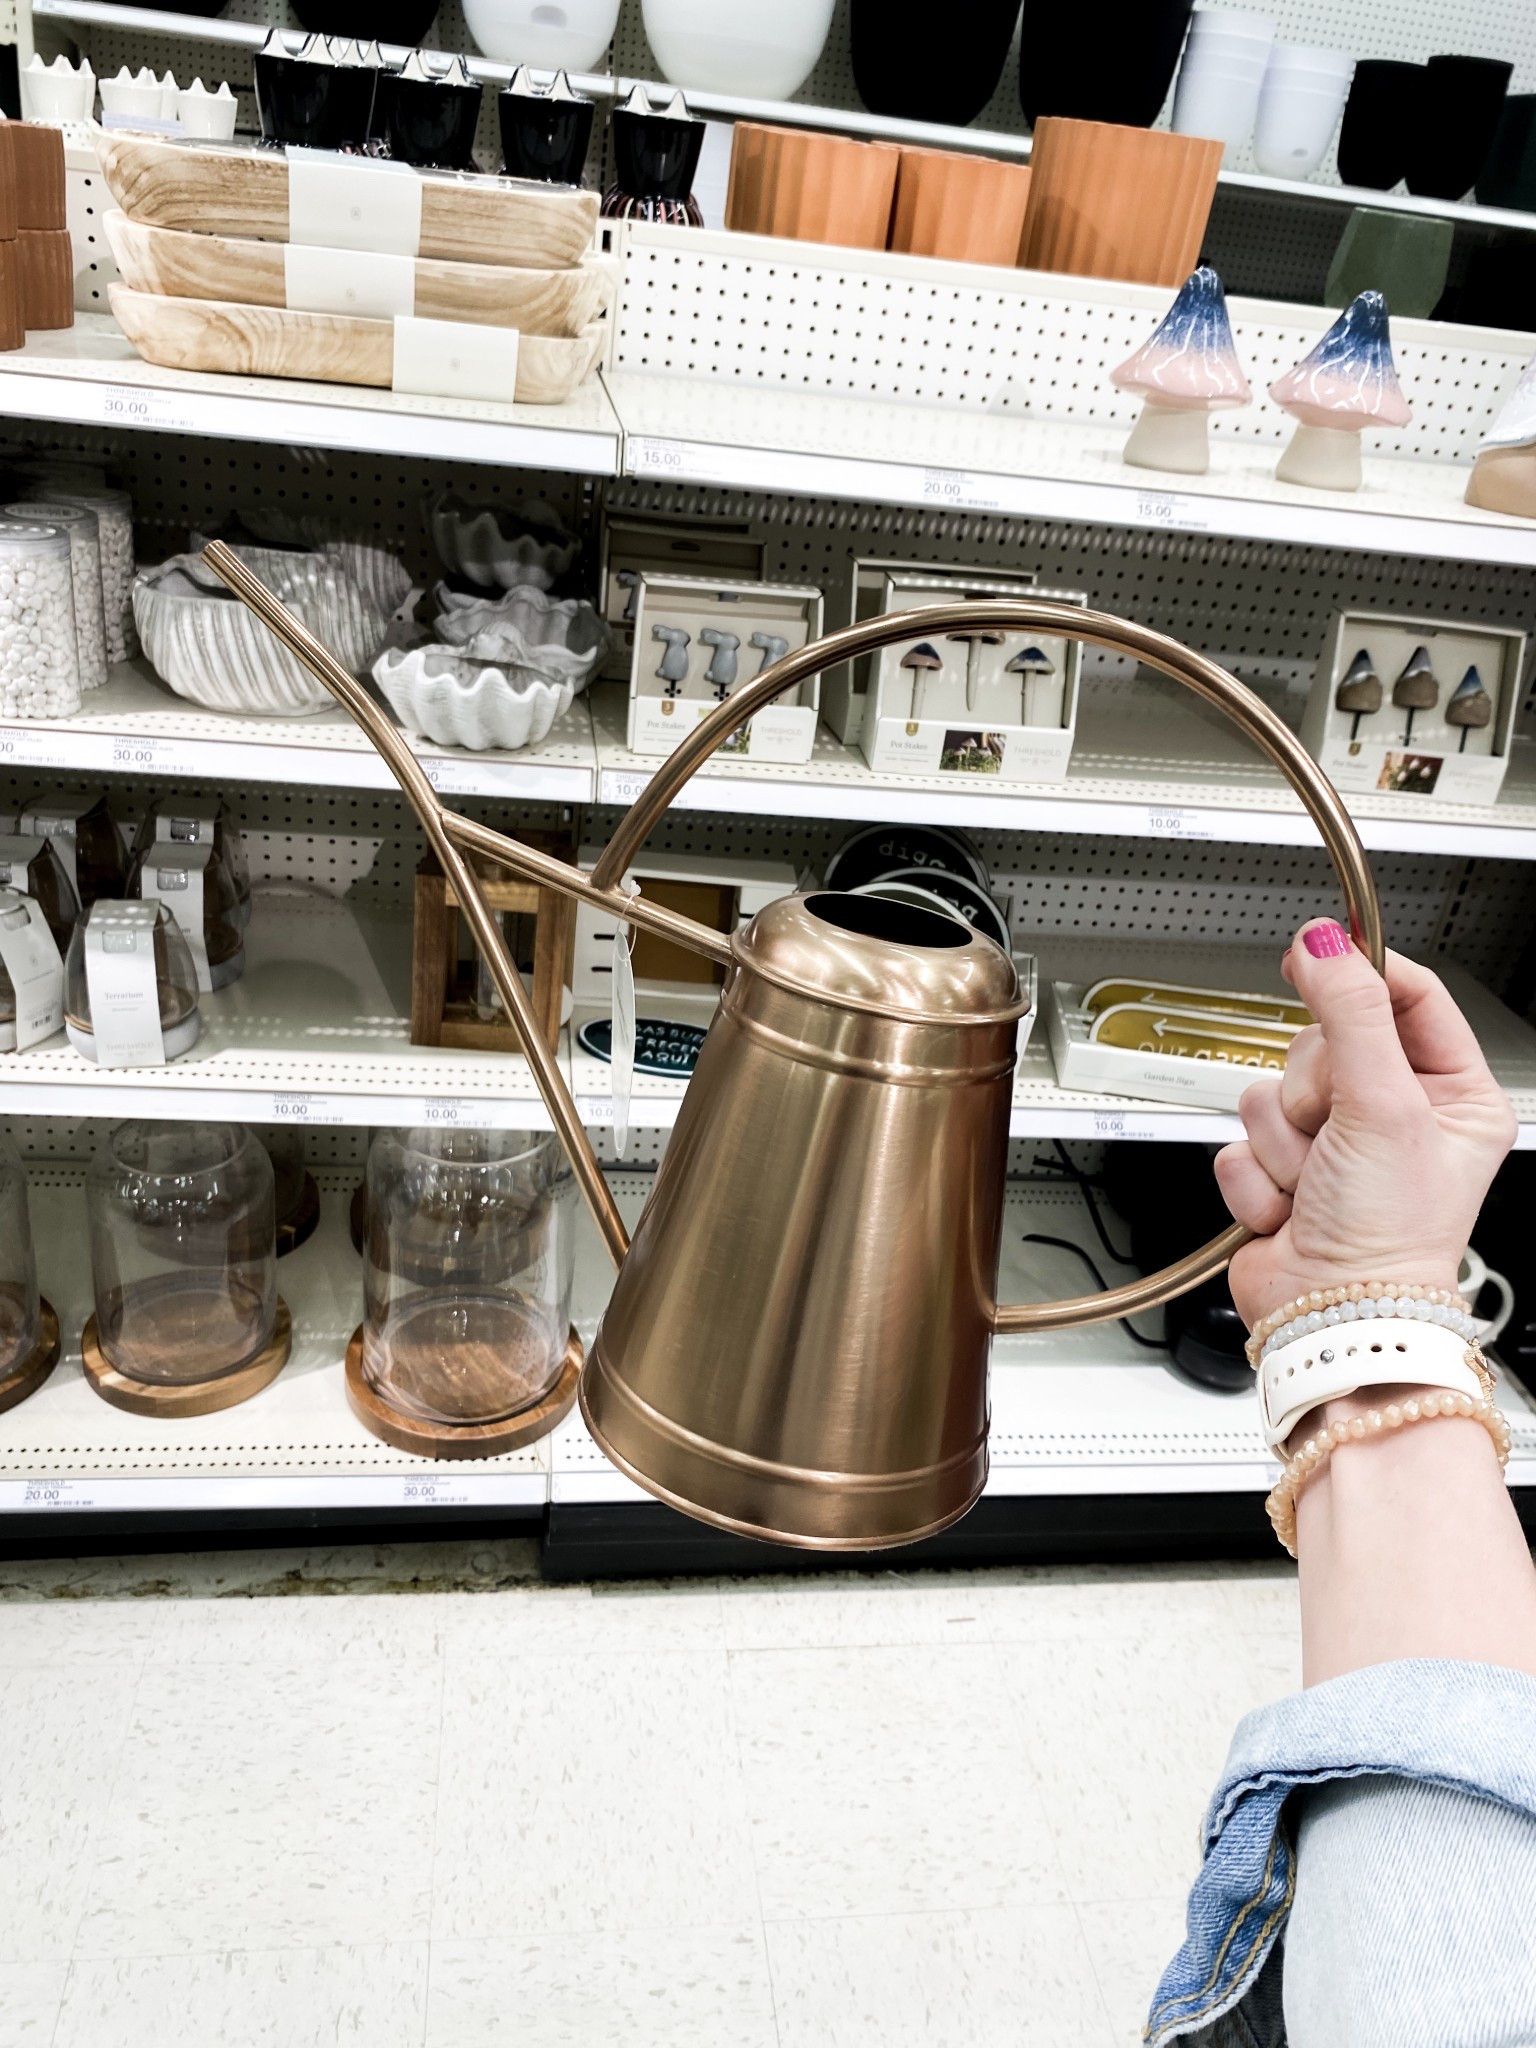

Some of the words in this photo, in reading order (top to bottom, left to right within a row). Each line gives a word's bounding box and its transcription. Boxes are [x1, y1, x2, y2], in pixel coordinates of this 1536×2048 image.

[104, 400, 148, 415] 30.00
[644, 451, 681, 466] 15.00
[924, 482, 960, 496] 20.00
[1138, 504, 1171, 518] 15.00
[113, 749, 153, 762] 30.00
[616, 784, 646, 796] 10.0
[1149, 818, 1180, 829] 10.00
[104, 991, 144, 1000] Terrarium
[670, 1028, 706, 1044] BUE
[1193, 1047, 1290, 1072] garde
[1144, 1071, 1174, 1084] Garden
[1176, 1075, 1195, 1087] Sign
[274, 1104, 307, 1115] 10.00
[425, 1108, 457, 1119] 10.00
[589, 1107, 613, 1117] 10.0
[1095, 1121, 1123, 1131] 10.00
[25, 1490, 59, 1500] 20.00
[403, 1486, 435, 1496] 30.00
